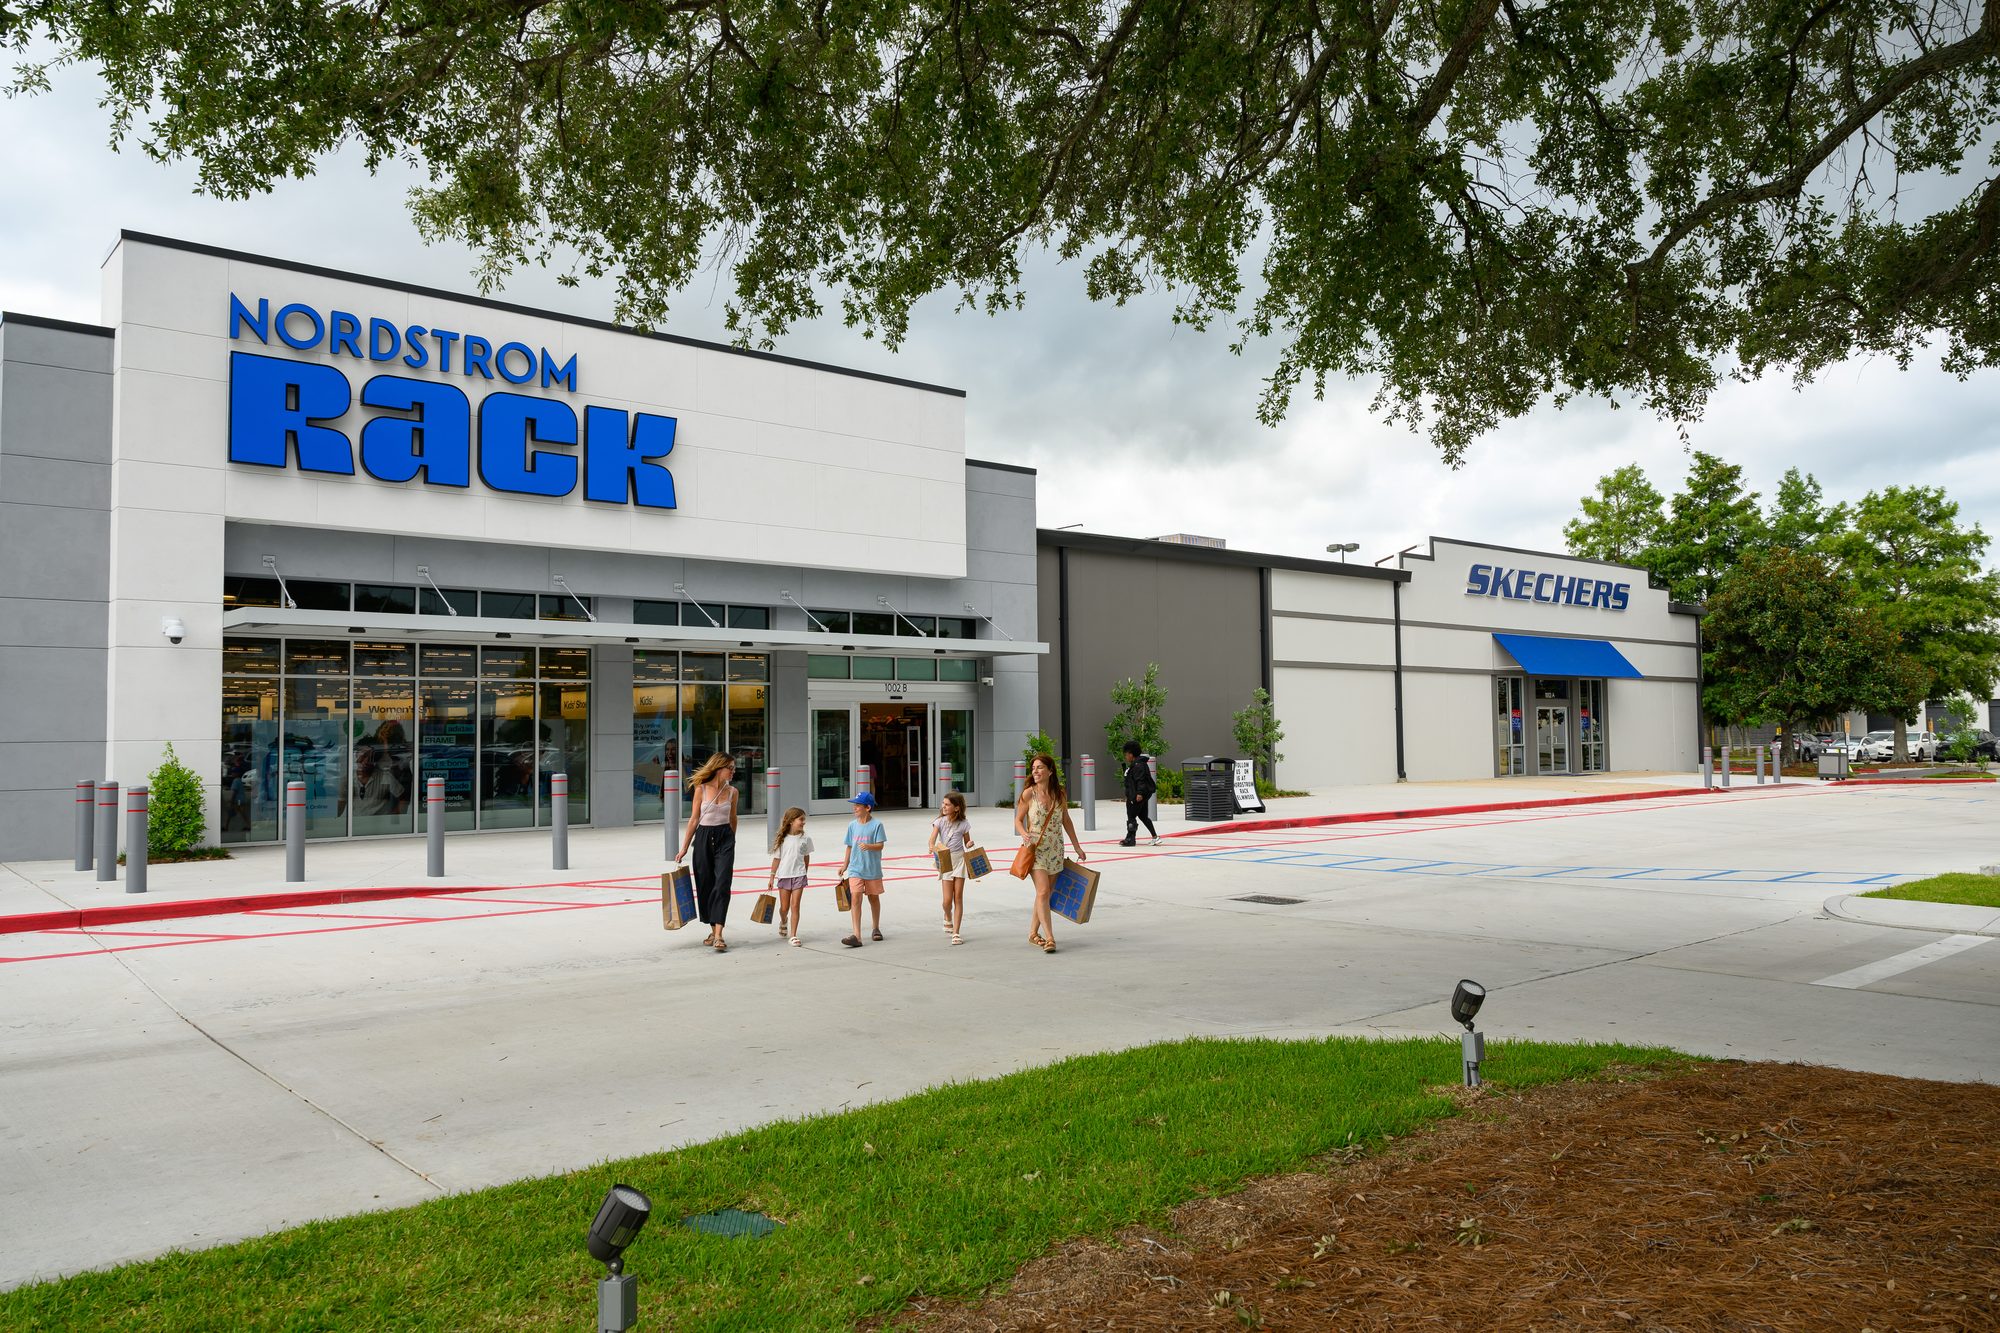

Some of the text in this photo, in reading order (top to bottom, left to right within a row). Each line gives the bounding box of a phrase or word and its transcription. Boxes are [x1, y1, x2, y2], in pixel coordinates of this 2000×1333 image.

[229, 291, 578, 393] NORDSTROM
[1464, 563, 1631, 612] SKECHERS
[884, 683, 907, 692] 1002 B
[424, 736, 455, 744] FRAME
